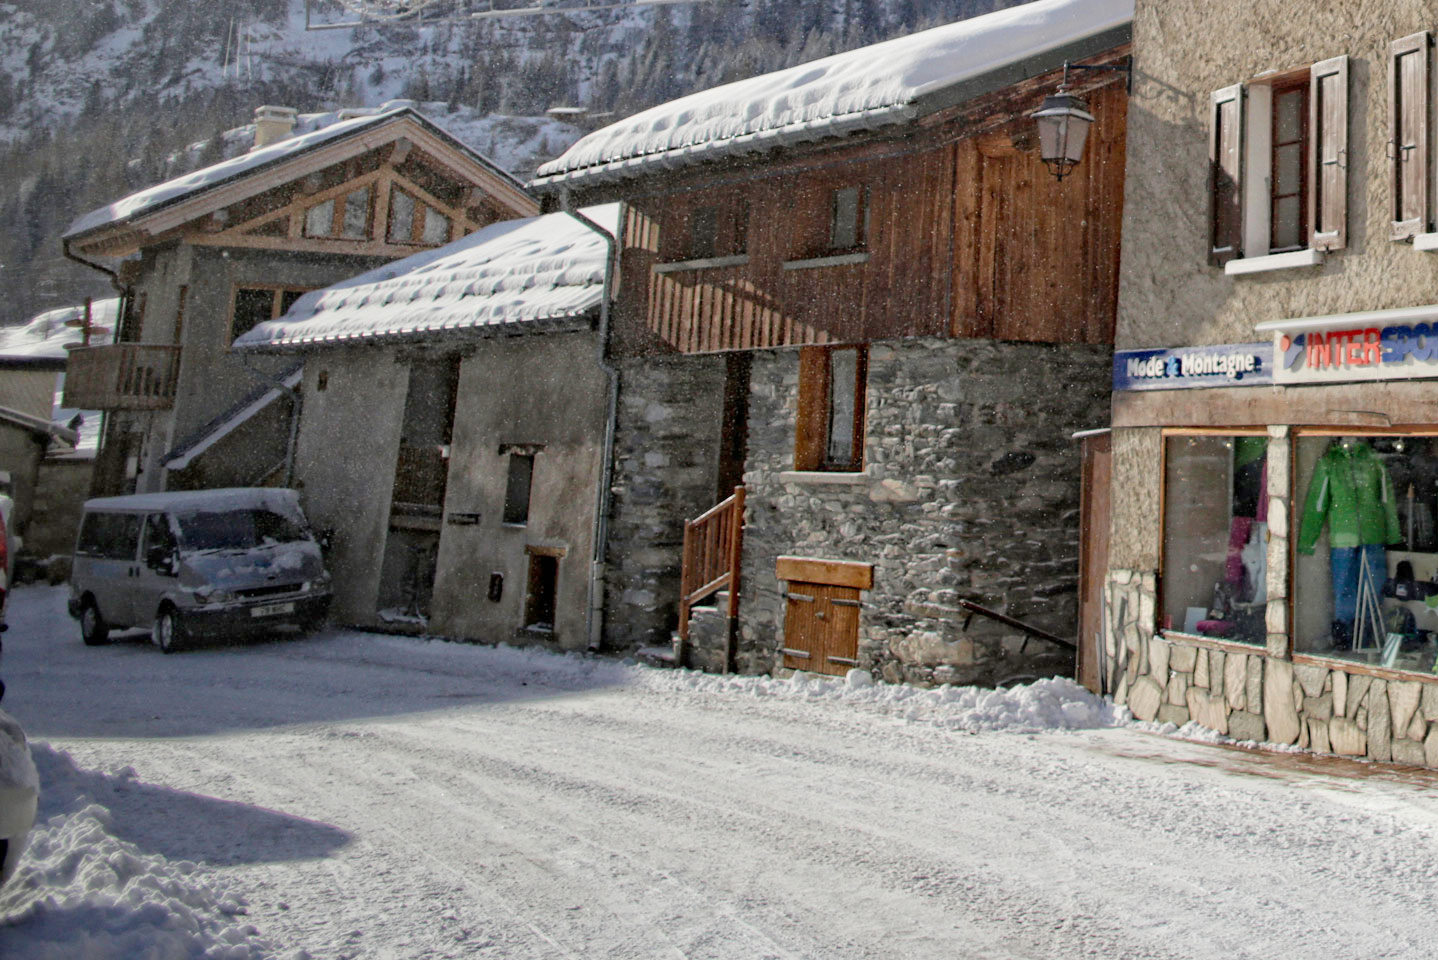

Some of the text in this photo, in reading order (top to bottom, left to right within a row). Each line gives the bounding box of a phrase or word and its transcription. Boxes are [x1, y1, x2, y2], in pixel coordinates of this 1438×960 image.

[1126, 352, 1256, 378] Mode & Montagne
